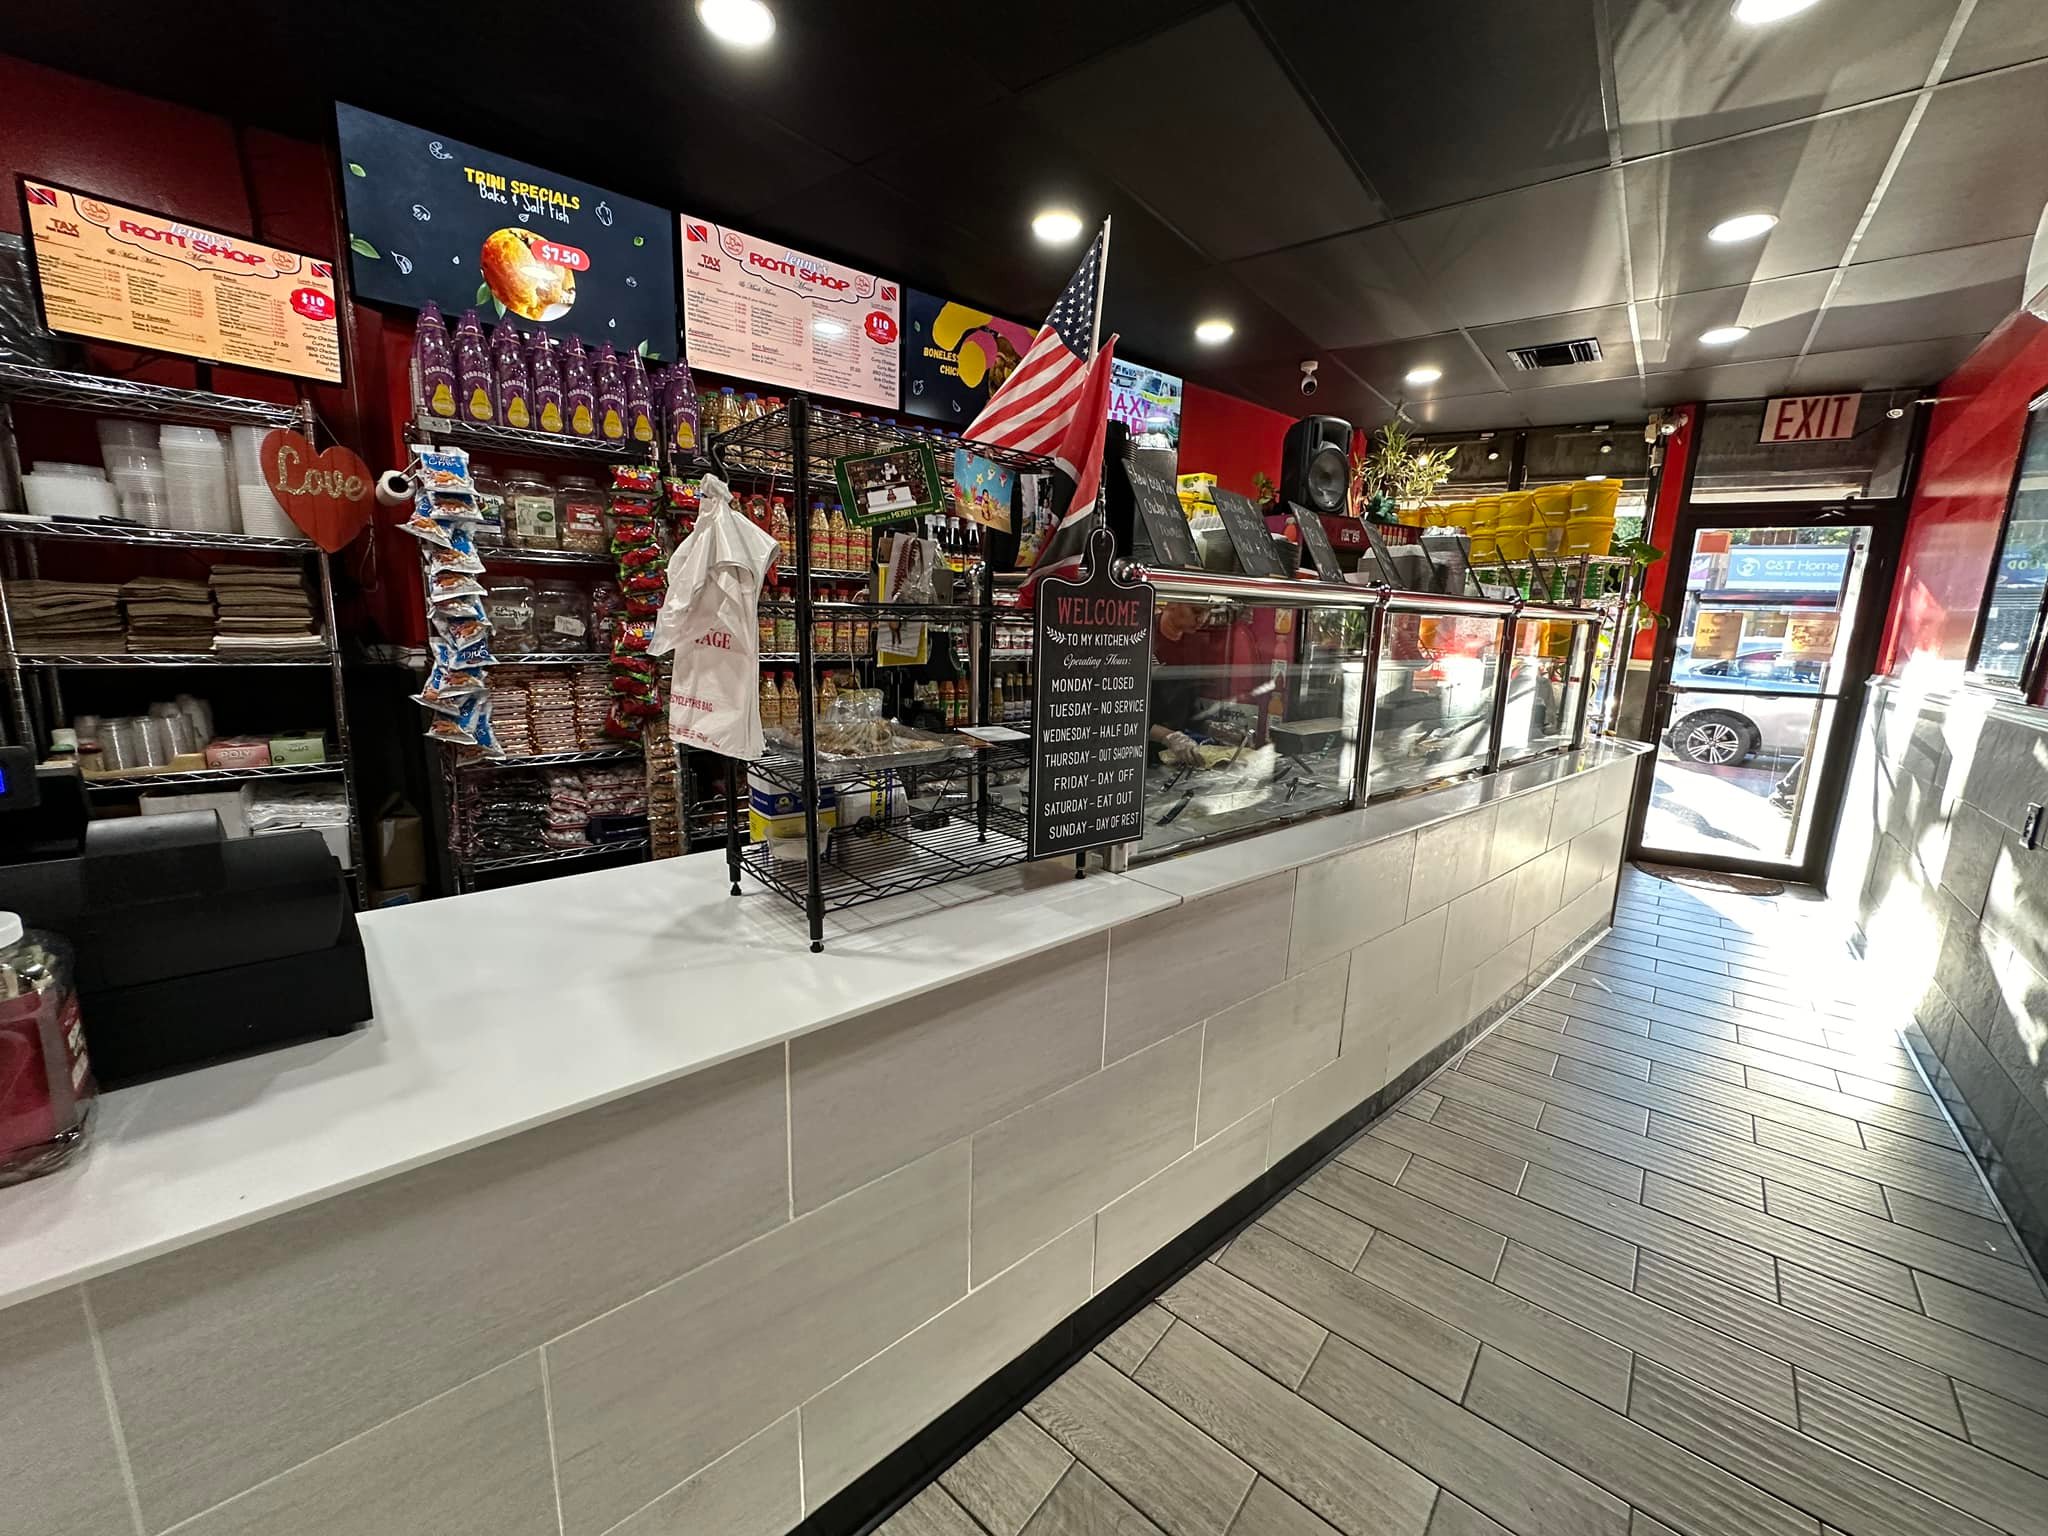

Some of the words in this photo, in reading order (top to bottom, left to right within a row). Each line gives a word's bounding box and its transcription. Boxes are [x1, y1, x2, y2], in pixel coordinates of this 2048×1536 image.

[464, 167, 505, 191] TRINI
[510, 180, 580, 210] SPECIALS
[480, 180, 508, 205] Bake
[522, 192, 544, 215] Salt
[549, 199, 570, 224] Fish
[50, 218, 79, 234] TAX
[120, 220, 186, 248] ROTI
[192, 240, 265, 266] SHOP
[542, 245, 580, 266] $7.50
[701, 254, 721, 268] TAX
[749, 252, 796, 278] ROTI
[799, 268, 850, 292] SHOP
[301, 292, 325, 307] $10
[872, 316, 889, 330] $10
[1773, 397, 1851, 440] EXIT
[275, 445, 368, 502] Love
[891, 508, 912, 519] MERRY
[1765, 559, 1795, 571] C&T
[1799, 560, 1840, 571] Home
[1057, 597, 1140, 626] WELCOME
[1067, 633, 1079, 646] TO
[1080, 633, 1093, 646] MY
[1094, 634, 1129, 647] KITCHEN
[1063, 653, 1102, 670] Operating
[1103, 653, 1132, 666] Hours:
[1051, 678, 1093, 693] MONDAY
[1102, 676, 1134, 691] CLOSED
[701, 702, 713, 712] BAG
[1049, 702, 1093, 719] TUESDAY
[1101, 701, 1112, 714] NO
[1114, 699, 1145, 714] SERVICE
[1042, 726, 1092, 743] WEDNESDAY
[1100, 724, 1122, 738] HALF
[1124, 722, 1139, 736] DAY
[220, 749, 251, 759] POLY
[1044, 750, 1091, 768] THURSDAY
[1098, 748, 1112, 762] OUT
[1112, 745, 1143, 761] SHOPPING
[1054, 774, 1089, 792] FRIDAY
[1098, 771, 1115, 785] DAY
[1118, 768, 1135, 783] OFF
[1044, 797, 1089, 817] SATURDAY
[1097, 793, 1114, 808] EAT
[1116, 790, 1134, 805] OUT
[1048, 821, 1088, 840] SUNDAY
[1096, 818, 1109, 831] DAY
[1110, 815, 1121, 829] OF
[1121, 811, 1140, 826] REST
